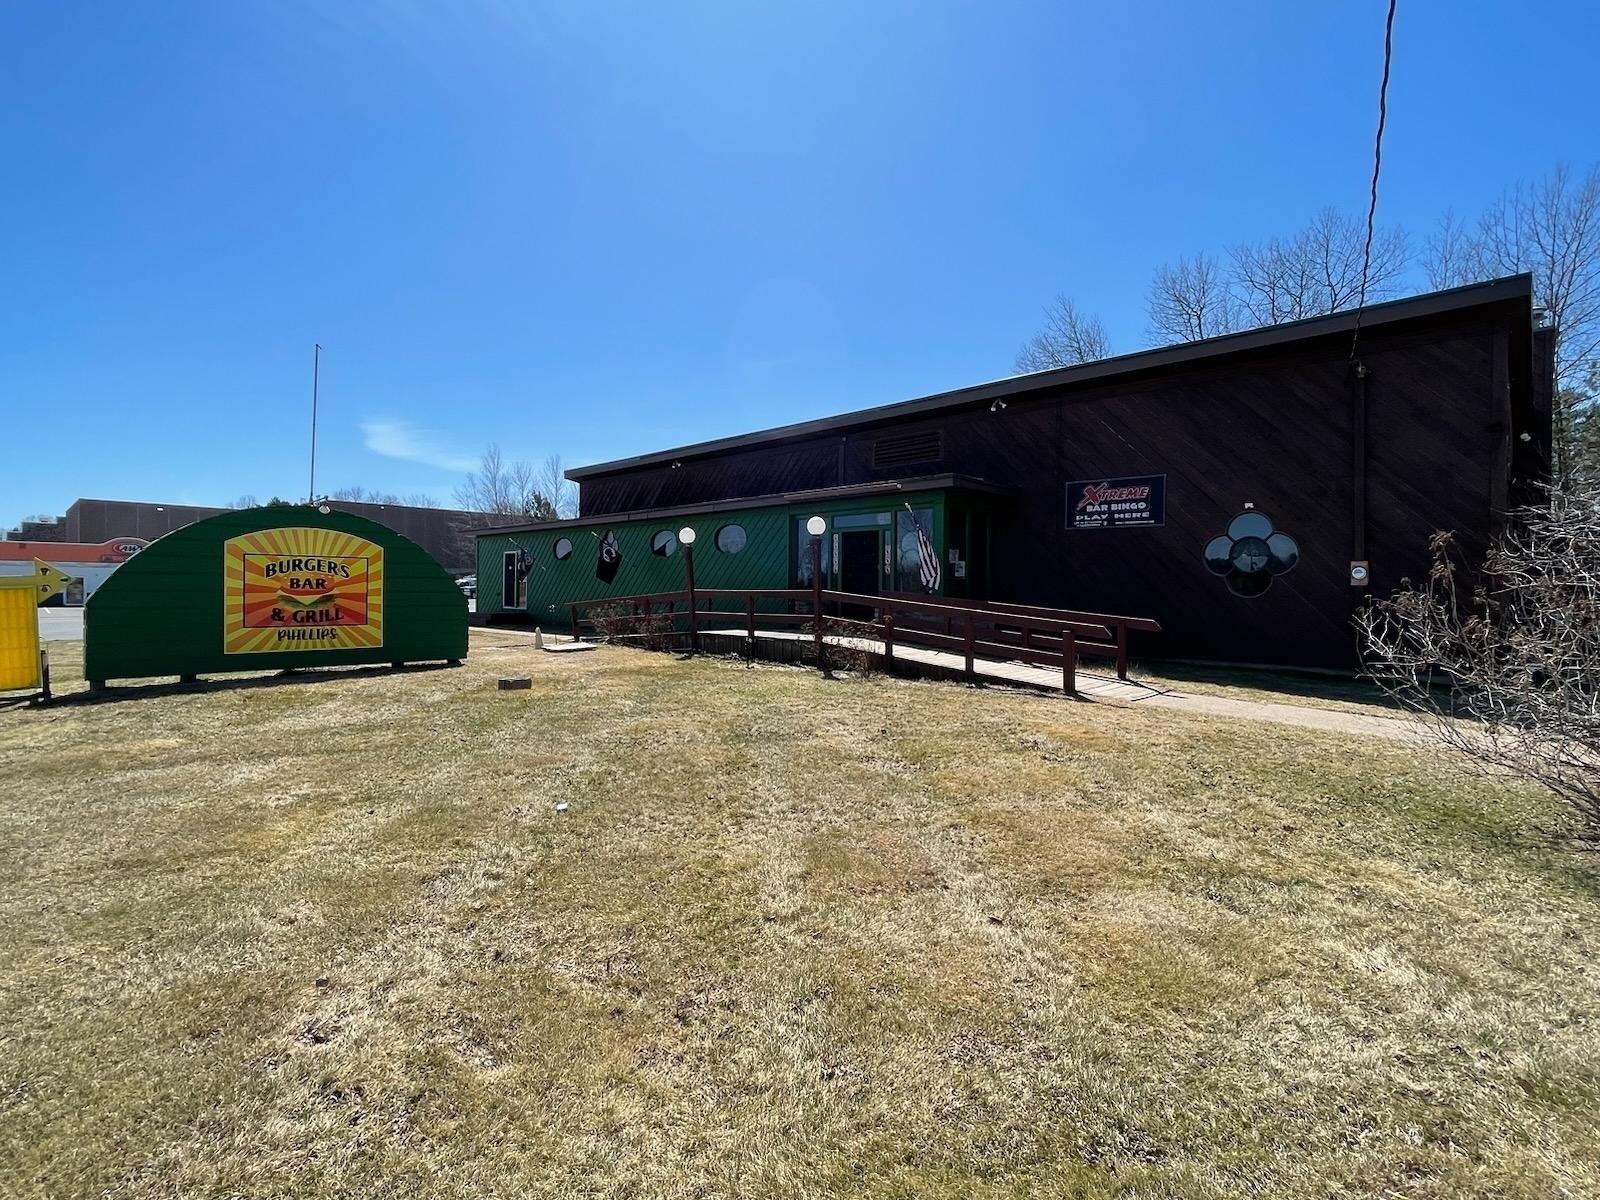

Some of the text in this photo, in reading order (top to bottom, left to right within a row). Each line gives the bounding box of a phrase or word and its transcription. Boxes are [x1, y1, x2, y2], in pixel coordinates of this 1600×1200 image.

[1076, 482, 1150, 511] XTREME
[1086, 502, 1147, 512] BAR BINGO
[1075, 511, 1150, 521] PLAY HERE
[265, 558, 350, 579] BURGERS
[289, 578, 327, 590] BAR
[271, 607, 344, 623] & GRILL
[278, 628, 337, 641] PHILLIPS
